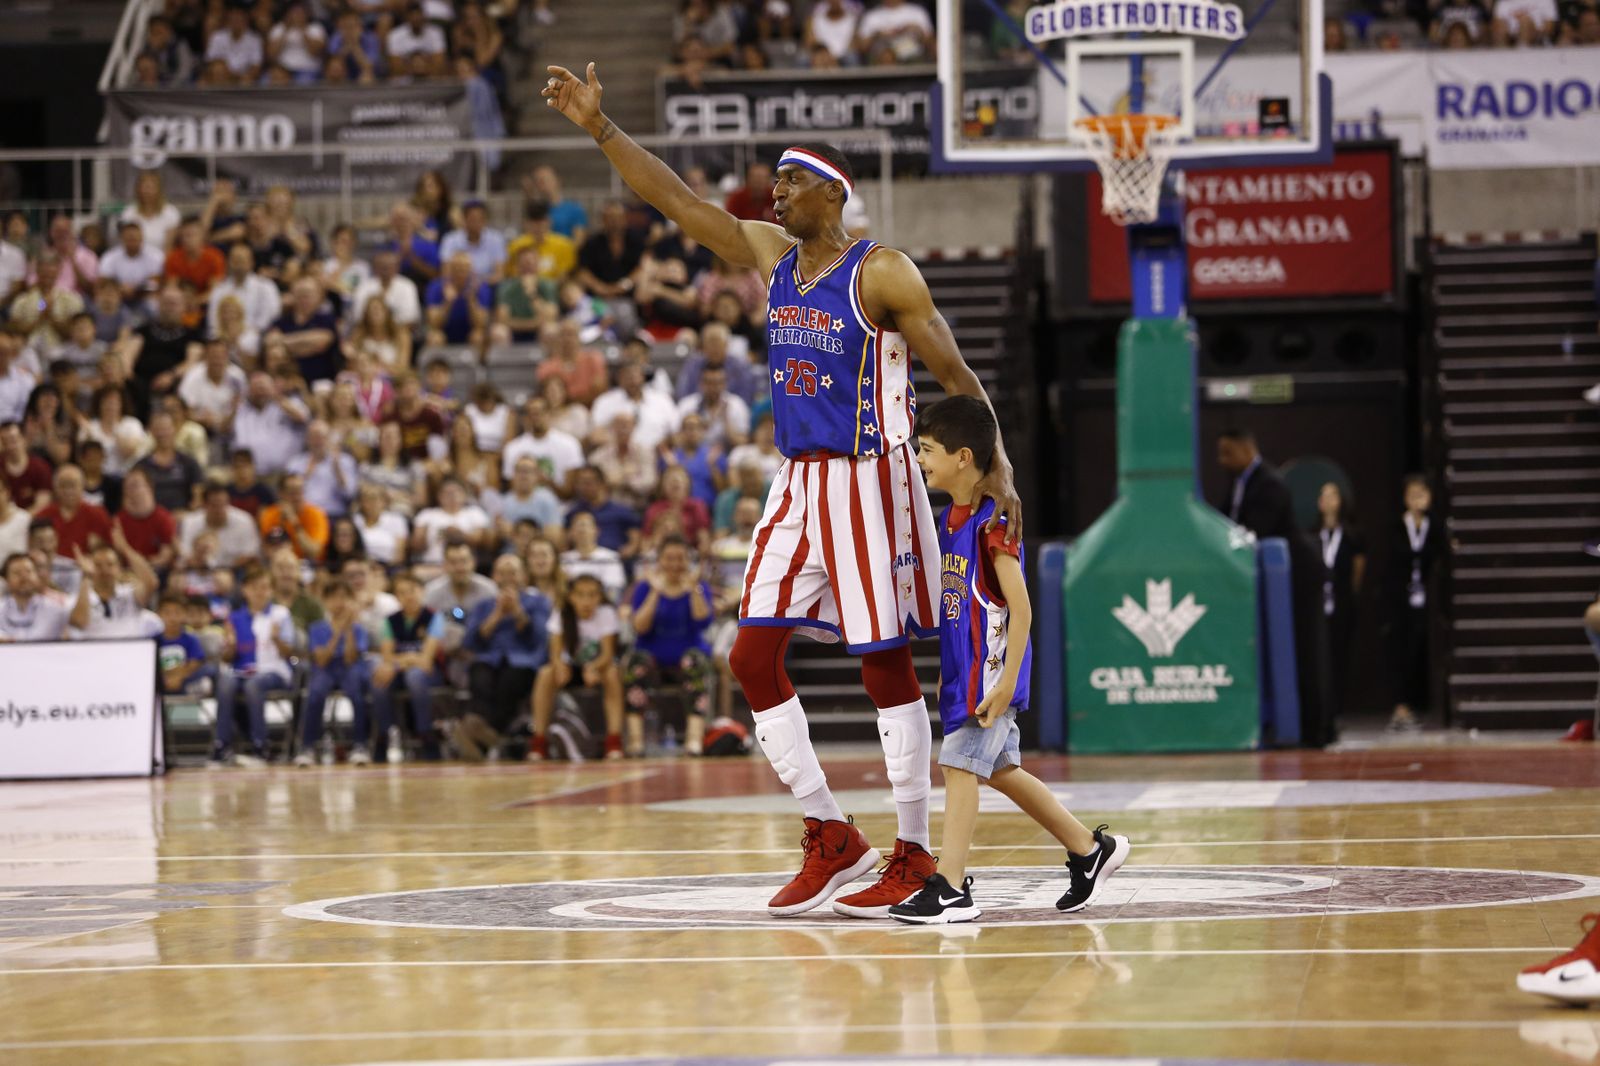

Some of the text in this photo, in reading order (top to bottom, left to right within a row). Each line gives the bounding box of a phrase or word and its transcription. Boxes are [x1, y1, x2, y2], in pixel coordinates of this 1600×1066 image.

[1031, 3, 1238, 36] GLOBETROTTERS
[1438, 80, 1600, 121] RADIO
[130, 114, 296, 170] gamo
[1186, 172, 1374, 203] NTAMIENTO
[1185, 207, 1350, 247] GRANADA
[786, 357, 817, 397] 26
[942, 553, 968, 577] RLEM
